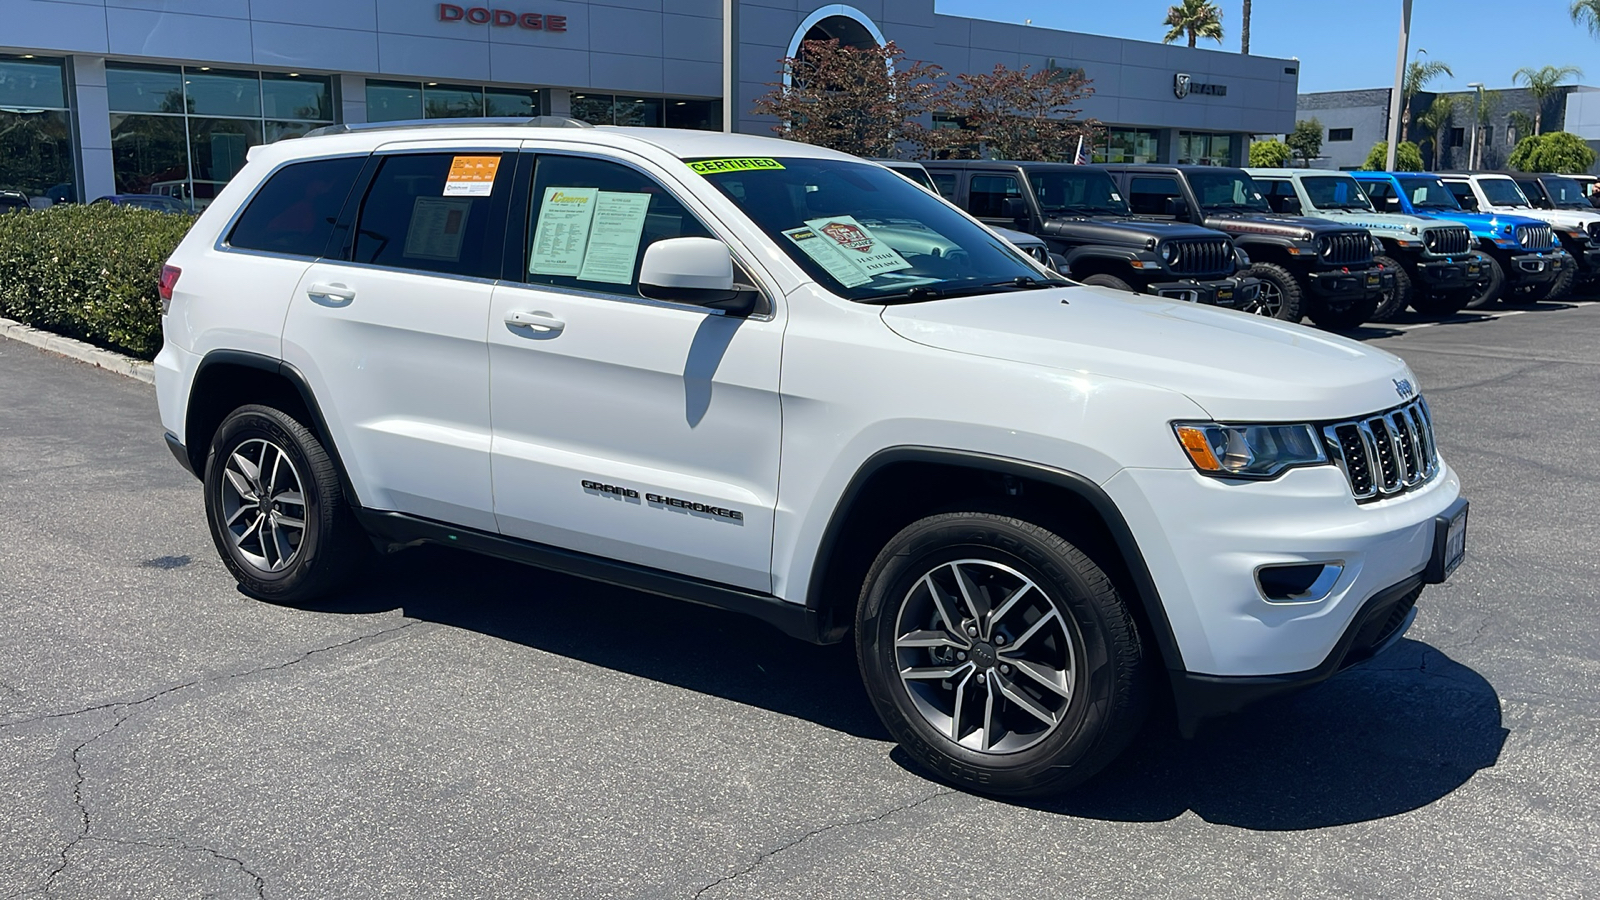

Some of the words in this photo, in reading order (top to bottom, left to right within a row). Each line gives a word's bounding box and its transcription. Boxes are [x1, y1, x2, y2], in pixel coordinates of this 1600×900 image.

[438, 3, 567, 31] DODGE
[1190, 82, 1227, 96] RAM
[691, 160, 777, 171] CERTIFIED
[581, 479, 640, 498] GRAND
[645, 492, 744, 521] CHEROKEE
